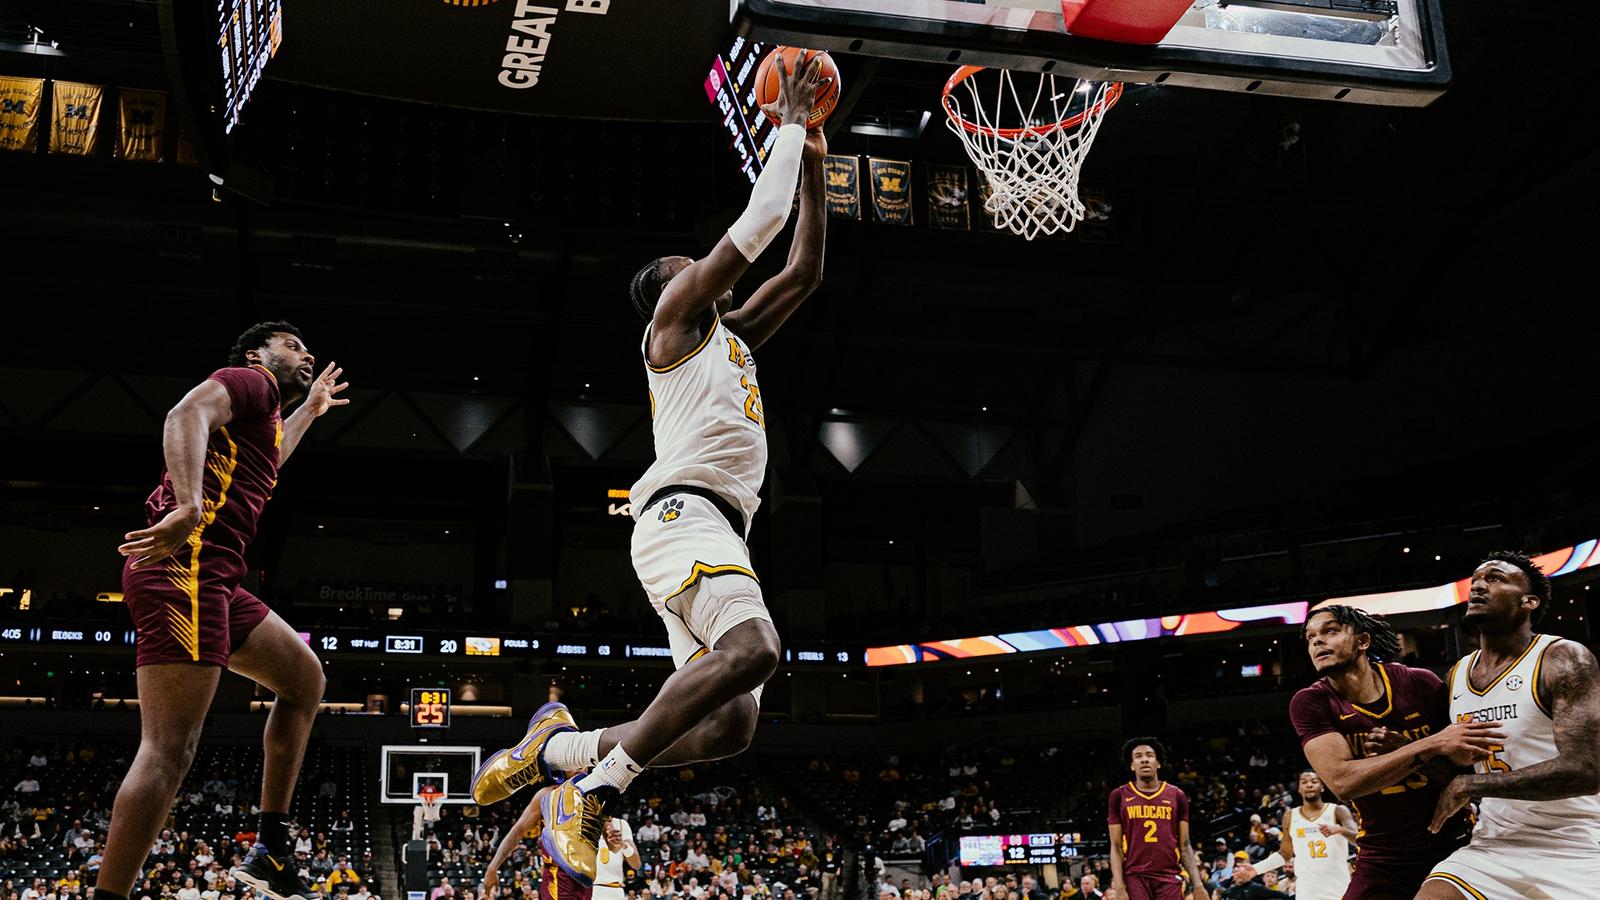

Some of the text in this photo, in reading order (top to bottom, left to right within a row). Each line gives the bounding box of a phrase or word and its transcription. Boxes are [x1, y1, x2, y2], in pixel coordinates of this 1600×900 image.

[321, 636, 338, 650] 12
[394, 639, 415, 650] 8:31
[440, 640, 458, 653] 20
[421, 692, 447, 704] 8:31
[417, 704, 443, 723] 25
[1126, 805, 1172, 820] WILDCATS
[1143, 820, 1158, 843] 2
[1008, 847, 1025, 859] 12
[1307, 840, 1328, 858] 12
